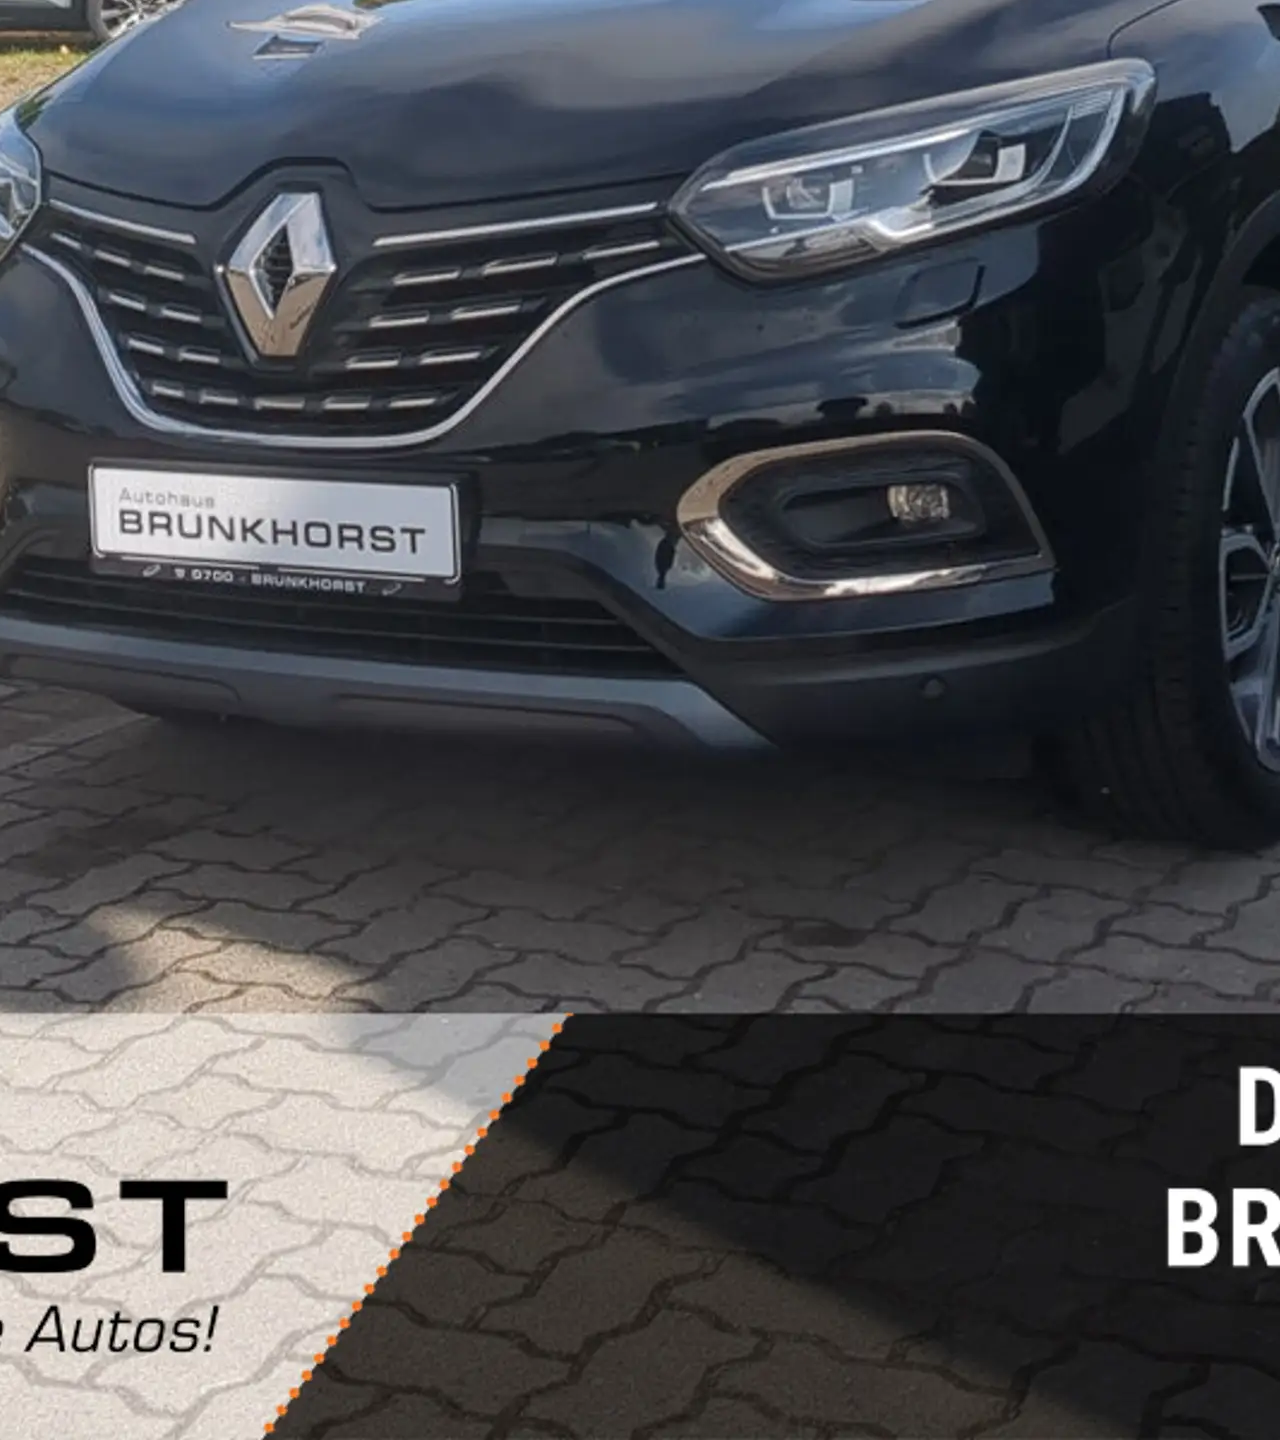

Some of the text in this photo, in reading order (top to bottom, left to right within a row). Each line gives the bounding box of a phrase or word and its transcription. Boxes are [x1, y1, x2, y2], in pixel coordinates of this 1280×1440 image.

[118, 486, 217, 509] Autohaus
[119, 509, 426, 554] BRUNKHORST
[250, 573, 367, 594] BRUNKHORST
